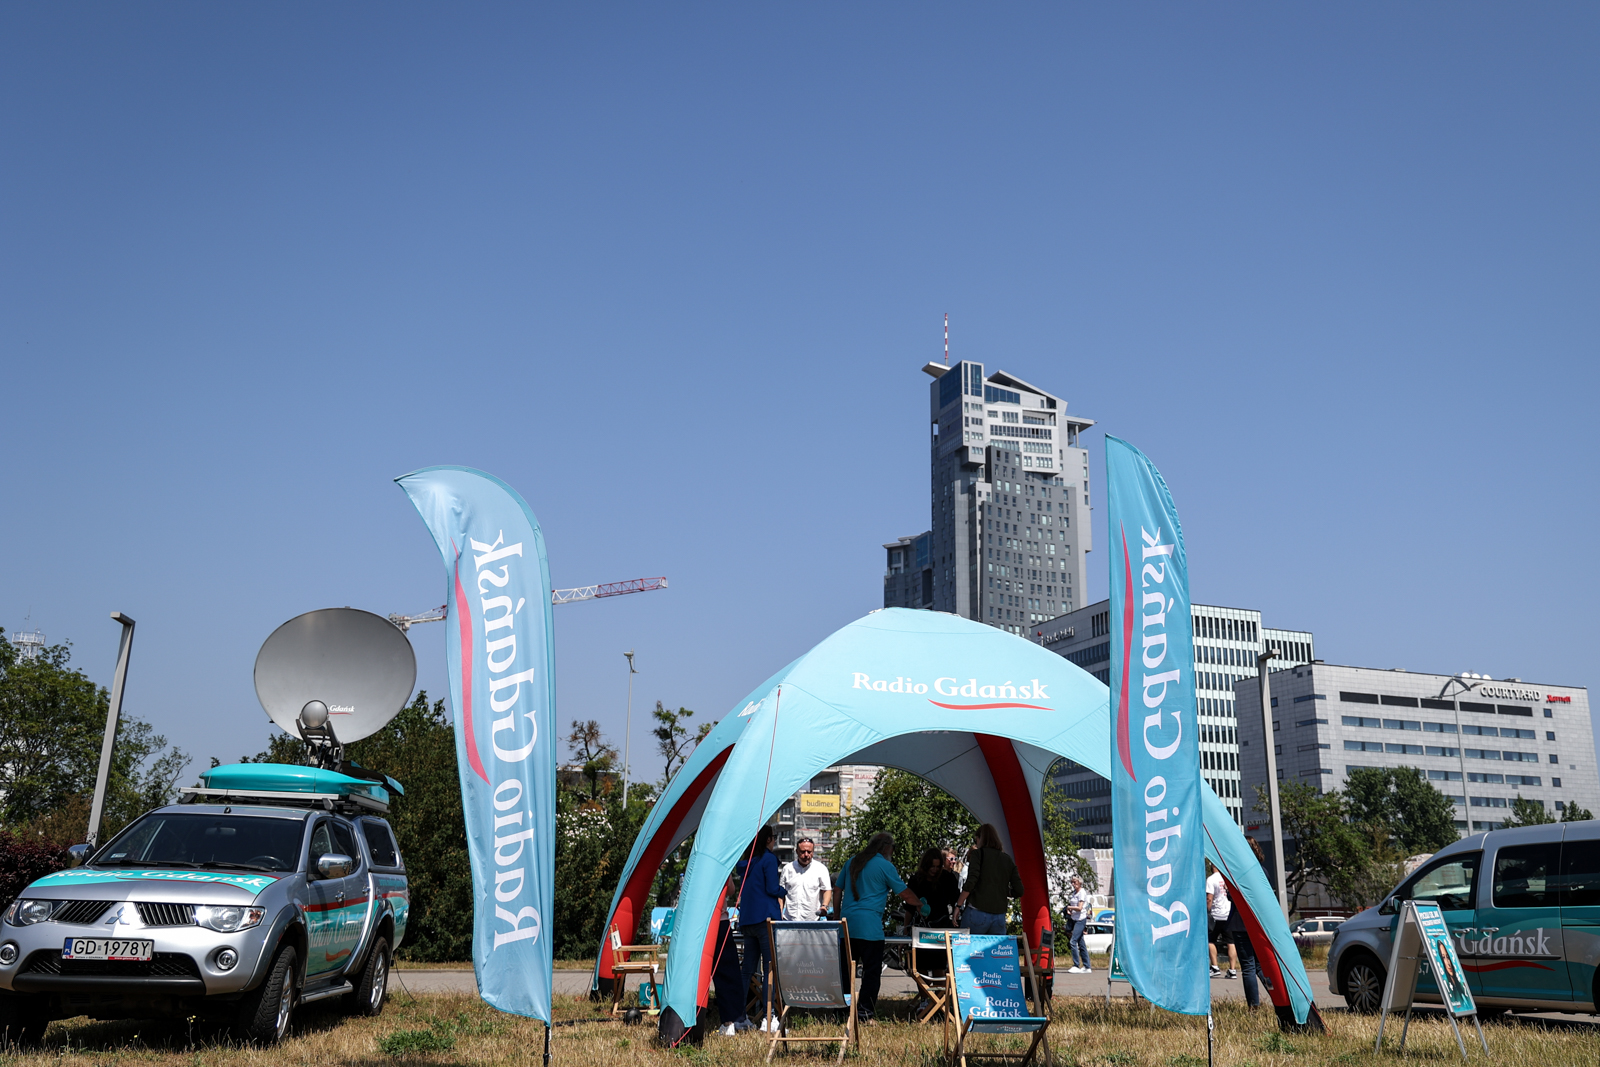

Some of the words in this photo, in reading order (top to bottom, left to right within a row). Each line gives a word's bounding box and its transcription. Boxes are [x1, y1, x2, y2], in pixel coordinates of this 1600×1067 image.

[851, 672, 929, 695] Radio
[934, 677, 1051, 699] Gdańsk
[1480, 685, 1541, 700] COURTYARD
[806, 800, 834, 808] budimex
[141, 870, 268, 888] Gdańsk
[74, 940, 97, 955] GD
[103, 940, 150, 956] 1978Y
[1460, 927, 1552, 956] Gdańsk
[973, 977, 1002, 986] Gdańsk
[982, 971, 1002, 979] Radio
[985, 996, 1020, 1008] Radio
[969, 1006, 1022, 1018] Gdańsk
